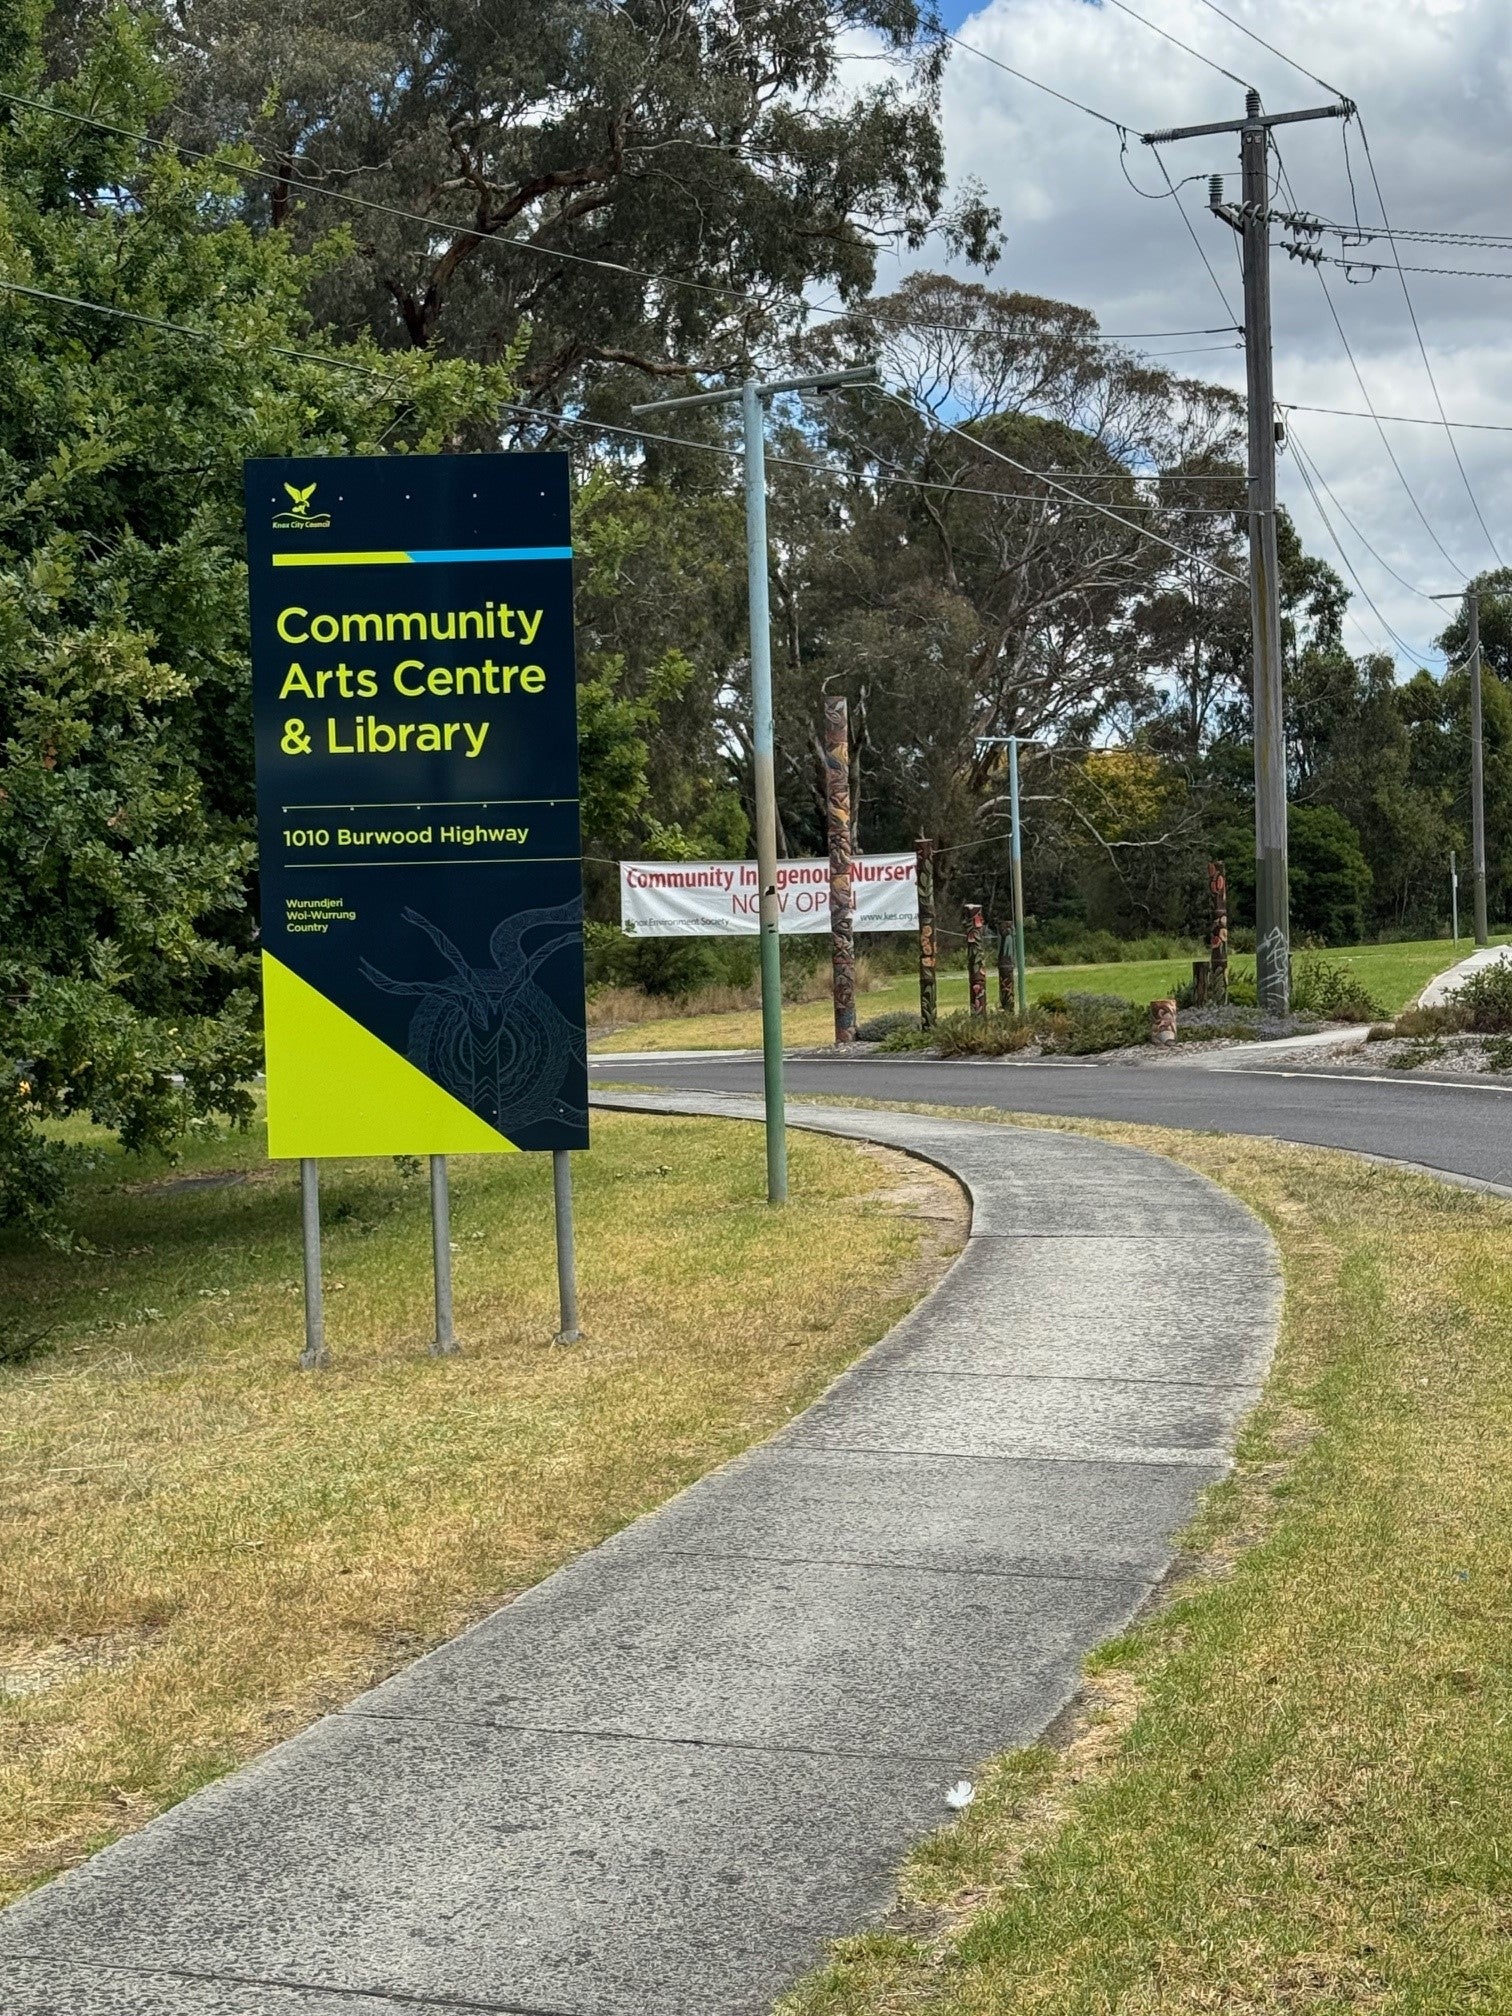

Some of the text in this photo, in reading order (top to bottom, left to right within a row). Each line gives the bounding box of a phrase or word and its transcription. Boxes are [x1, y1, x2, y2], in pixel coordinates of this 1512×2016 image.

[290, 521, 305, 529] City
[305, 520, 331, 528] Council
[276, 601, 544, 645] Community
[278, 659, 546, 699] Arts Centre
[280, 716, 490, 758] & Library
[282, 825, 530, 847] 1010 Burwood Highway
[626, 866, 734, 891] Community
[740, 866, 831, 890] Ingenou
[285, 898, 344, 909] Wurundjeri
[286, 922, 329, 933] Country
